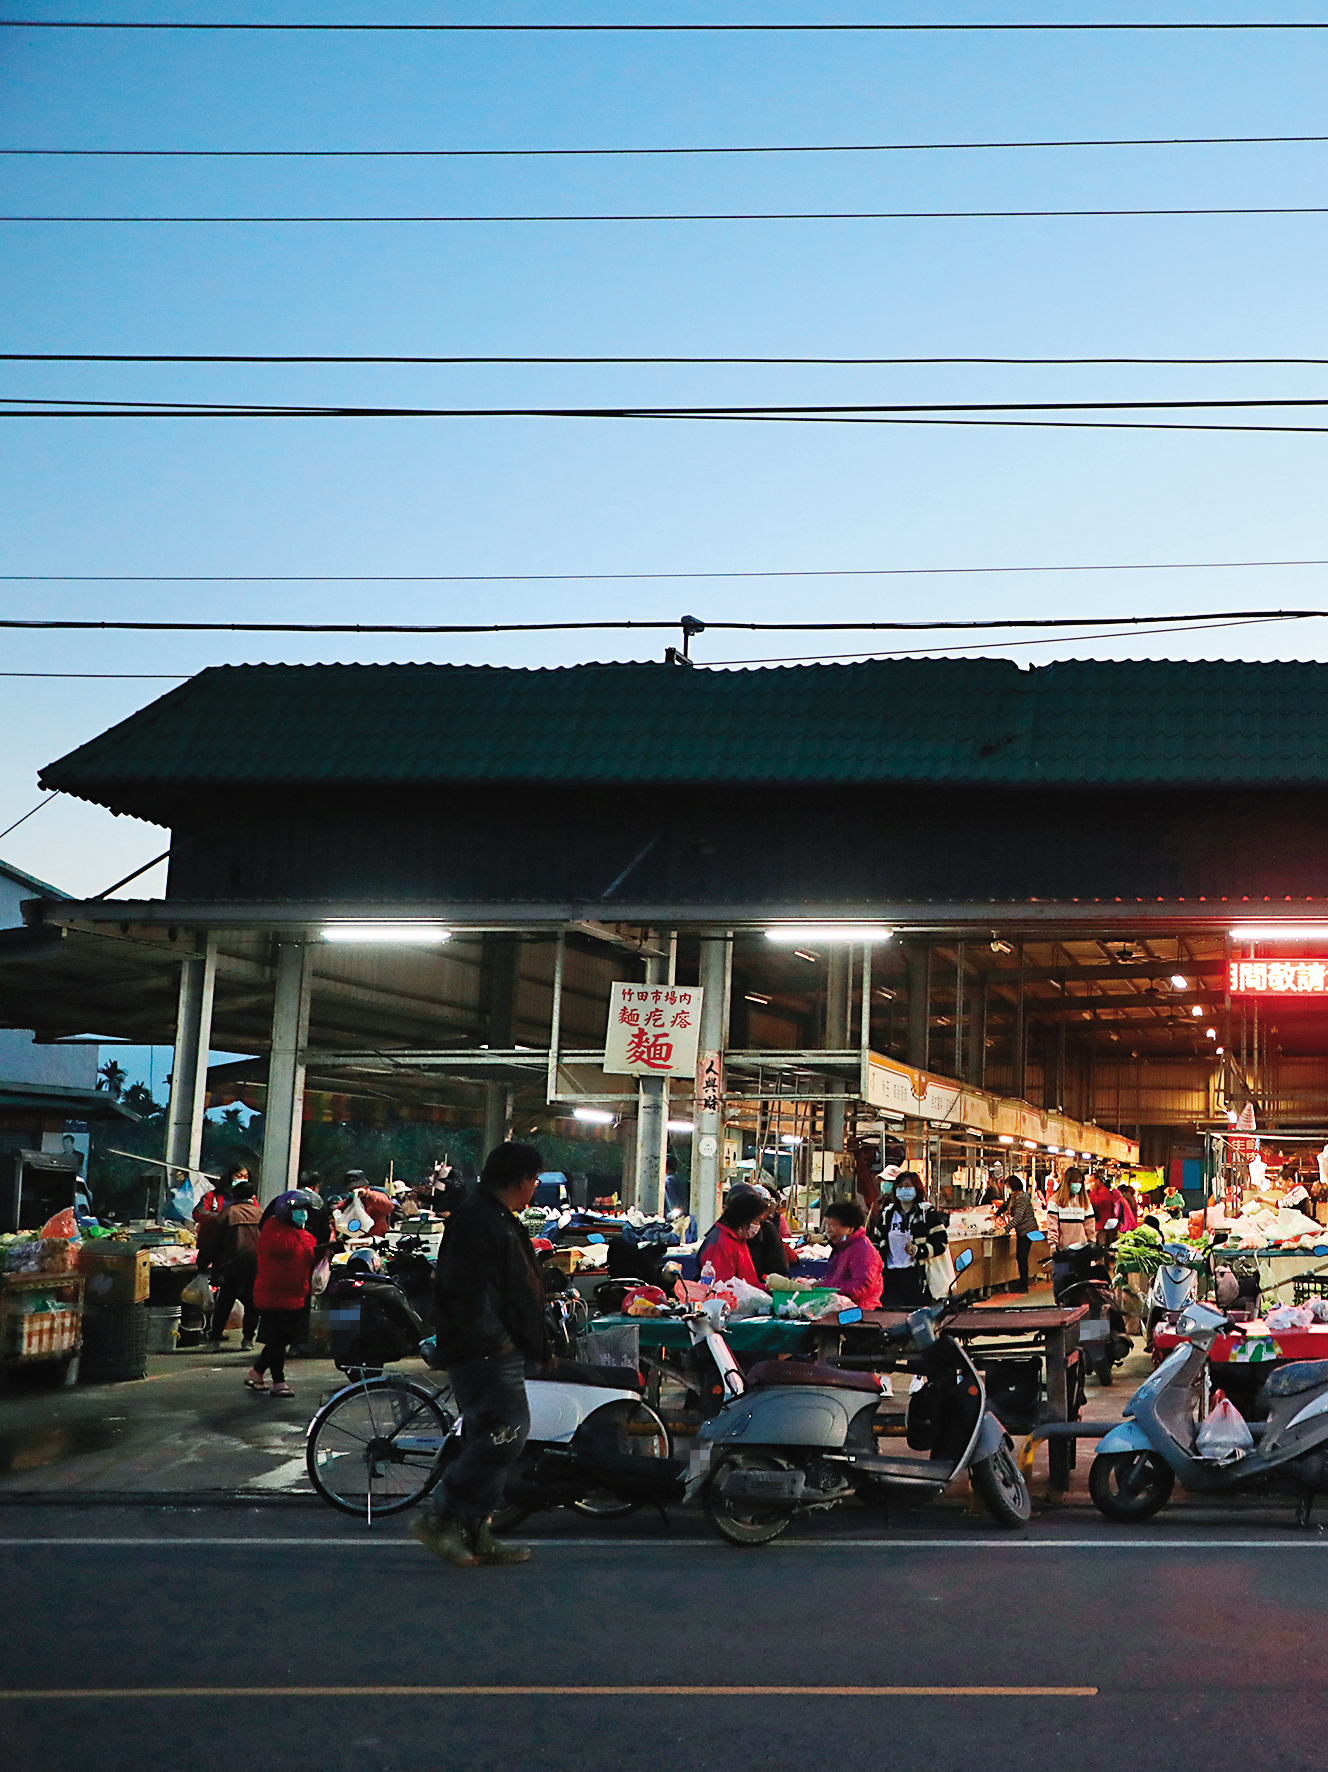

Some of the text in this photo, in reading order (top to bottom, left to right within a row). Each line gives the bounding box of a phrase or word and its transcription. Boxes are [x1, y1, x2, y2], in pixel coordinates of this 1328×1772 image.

[621, 988, 692, 1005] 竹田市場內
[626, 1027, 673, 1069] 麵
